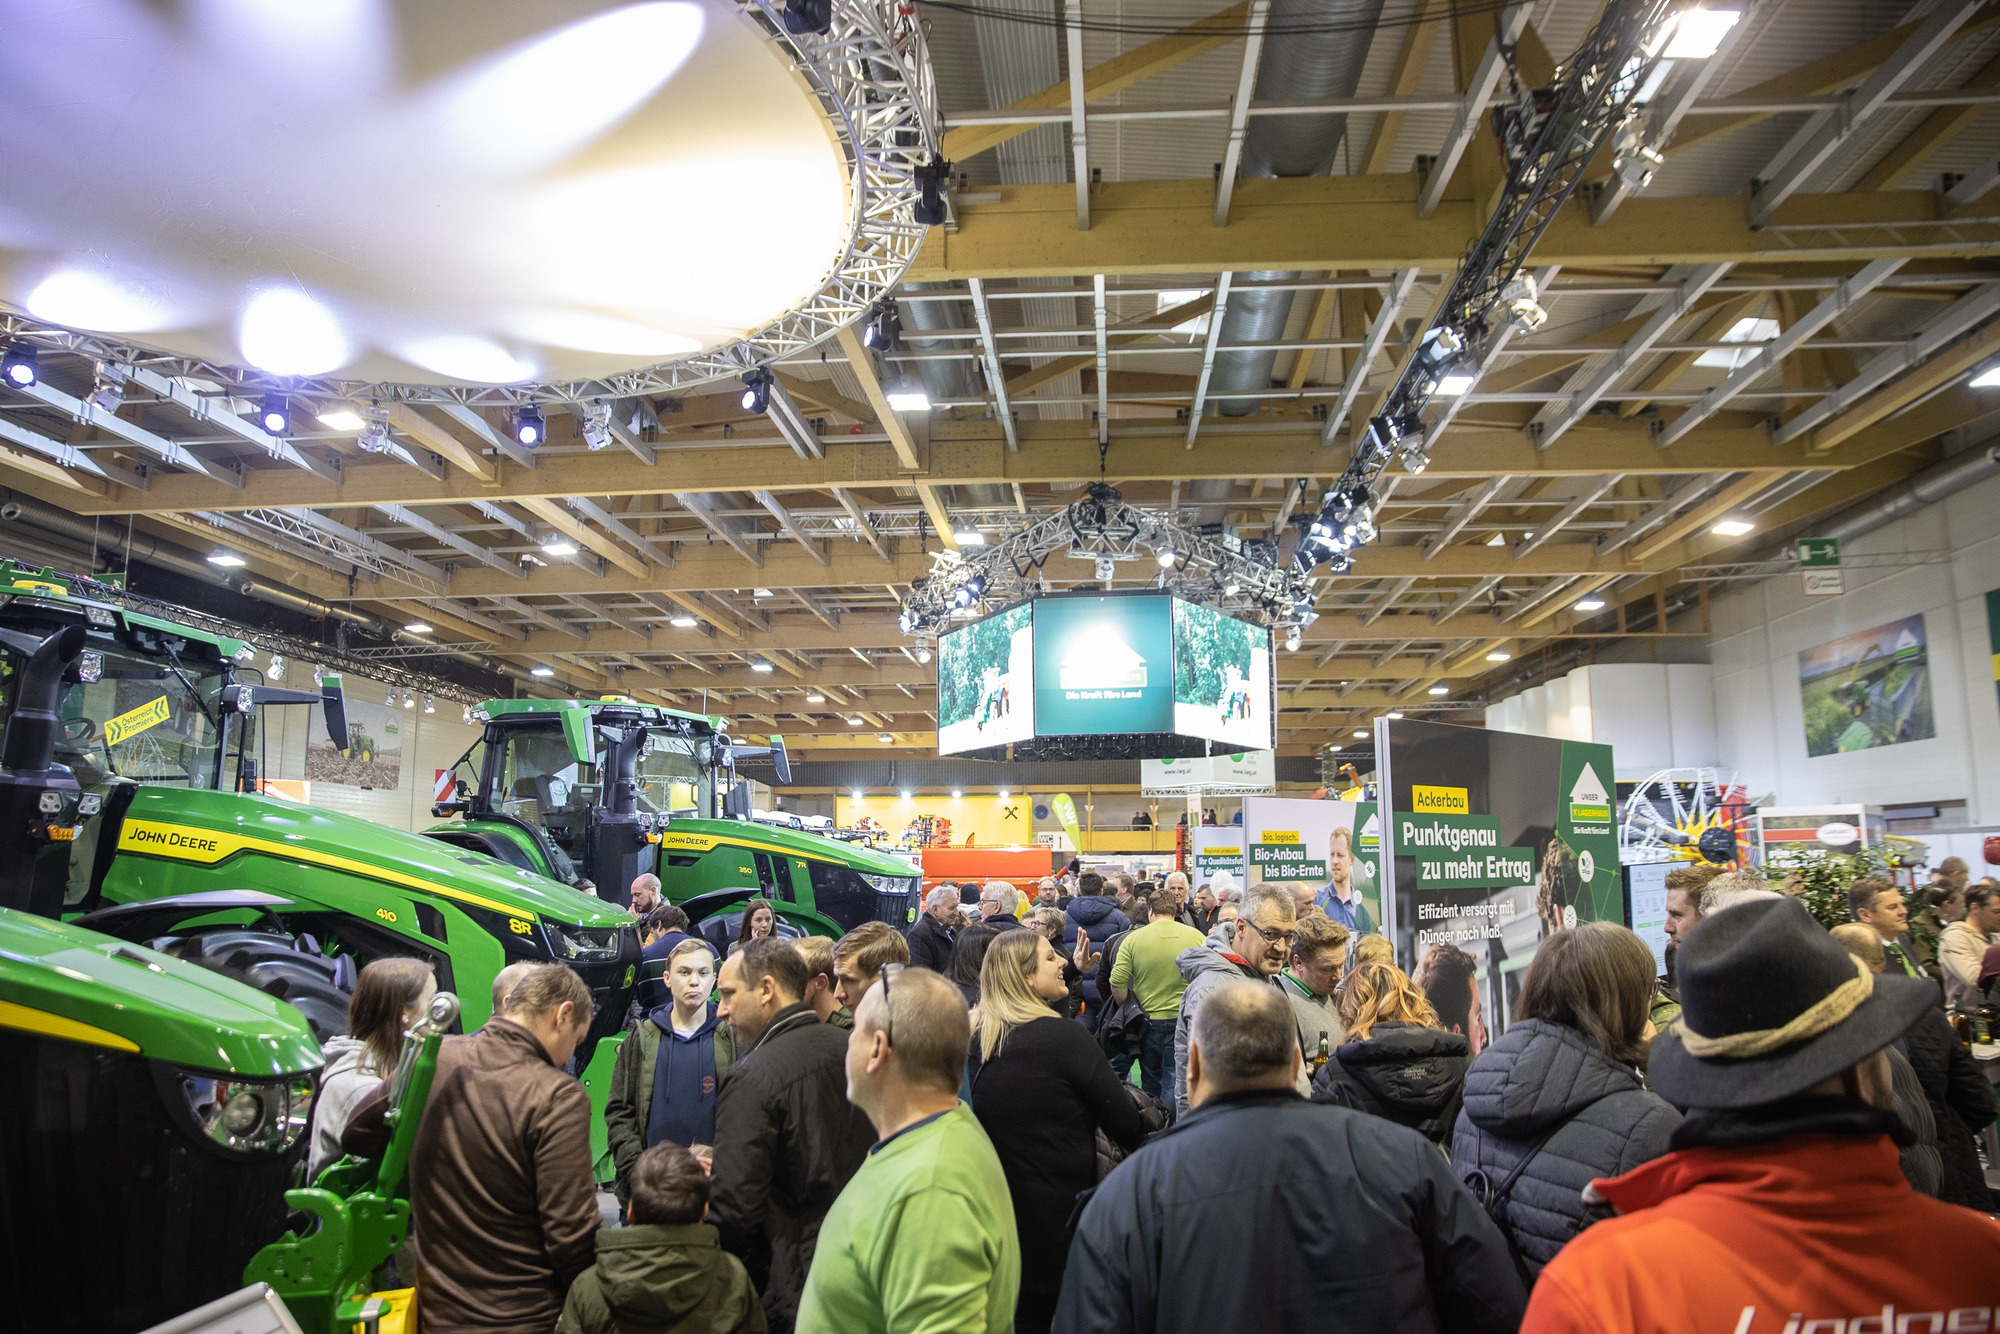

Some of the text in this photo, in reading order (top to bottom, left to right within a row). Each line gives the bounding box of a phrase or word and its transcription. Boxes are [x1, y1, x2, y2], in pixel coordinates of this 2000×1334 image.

[1065, 691, 1080, 700] Die
[1081, 690, 1103, 700] Kraft
[1121, 689, 1142, 699] Land
[122, 707, 154, 726] Österreich
[1417, 792, 1464, 808] Ackerbau
[1580, 793, 1599, 801] UNSER
[1577, 808, 1609, 818] LAGERHAUS
[129, 827, 218, 852] JOHN DEERE
[667, 836, 709, 846] JOHN DEERE
[1039, 834, 1054, 844] WC
[1263, 833, 1298, 843] bio. logisch.
[1403, 821, 1497, 852] Punktgenau
[1198, 857, 1208, 865] Ihr
[1254, 848, 1304, 861] Bio-Anbau
[738, 866, 753, 874] 350
[795, 861, 807, 869] 7R
[1265, 864, 1325, 878] bis Bio-Ernte
[1422, 854, 1531, 883] zu mehr Ertrag
[376, 907, 398, 923] 410
[1418, 900, 1514, 920] Effizient versorgt mit
[508, 918, 533, 936] 8R
[1419, 923, 1503, 947] Dünger nach Maß.
[1733, 1304, 2000, 1334] Lindne
